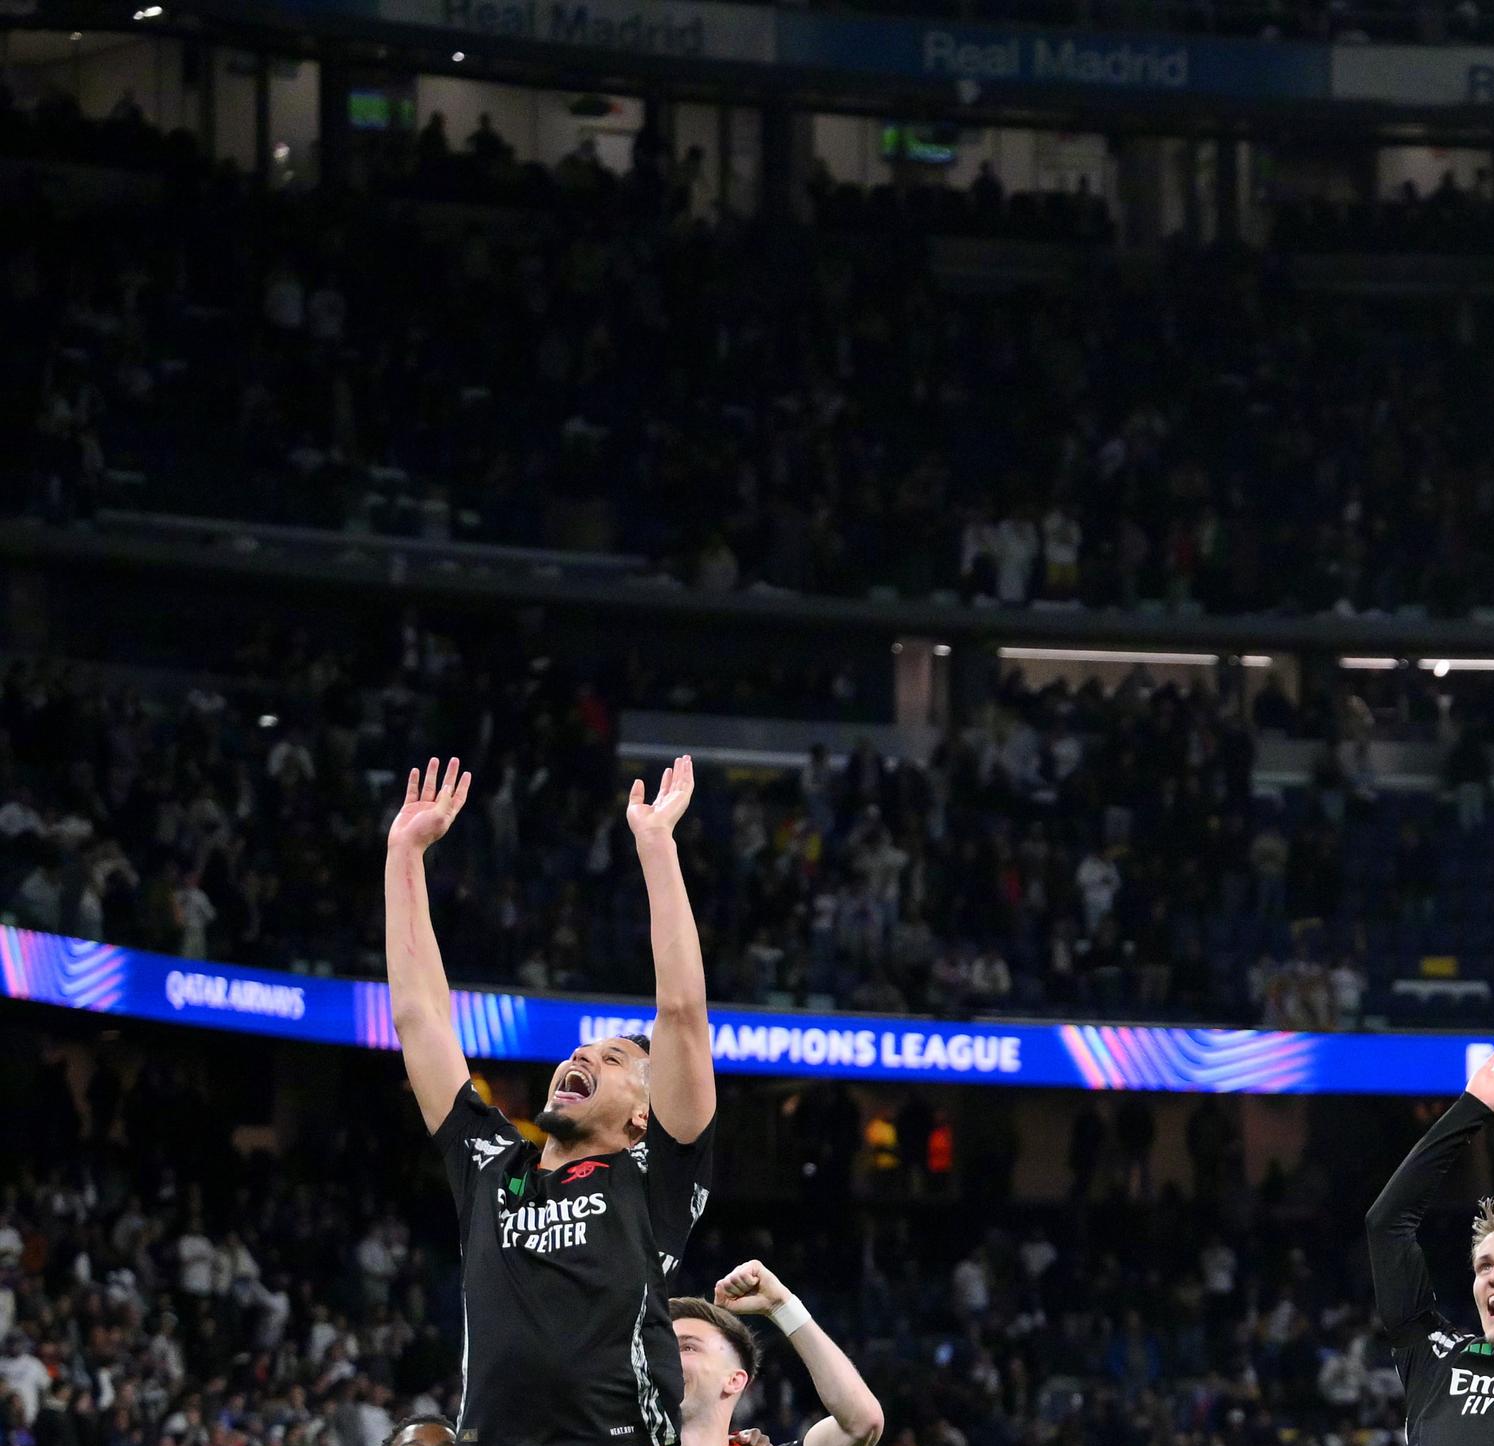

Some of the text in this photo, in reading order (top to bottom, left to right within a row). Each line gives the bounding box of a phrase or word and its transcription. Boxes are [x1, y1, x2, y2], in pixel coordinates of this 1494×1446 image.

[921, 32, 1188, 87] Real Madrid
[709, 1020, 876, 1068] AMPIONS
[881, 1031, 1022, 1074] LEAGUE
[1460, 1394, 1494, 1416] FLY
